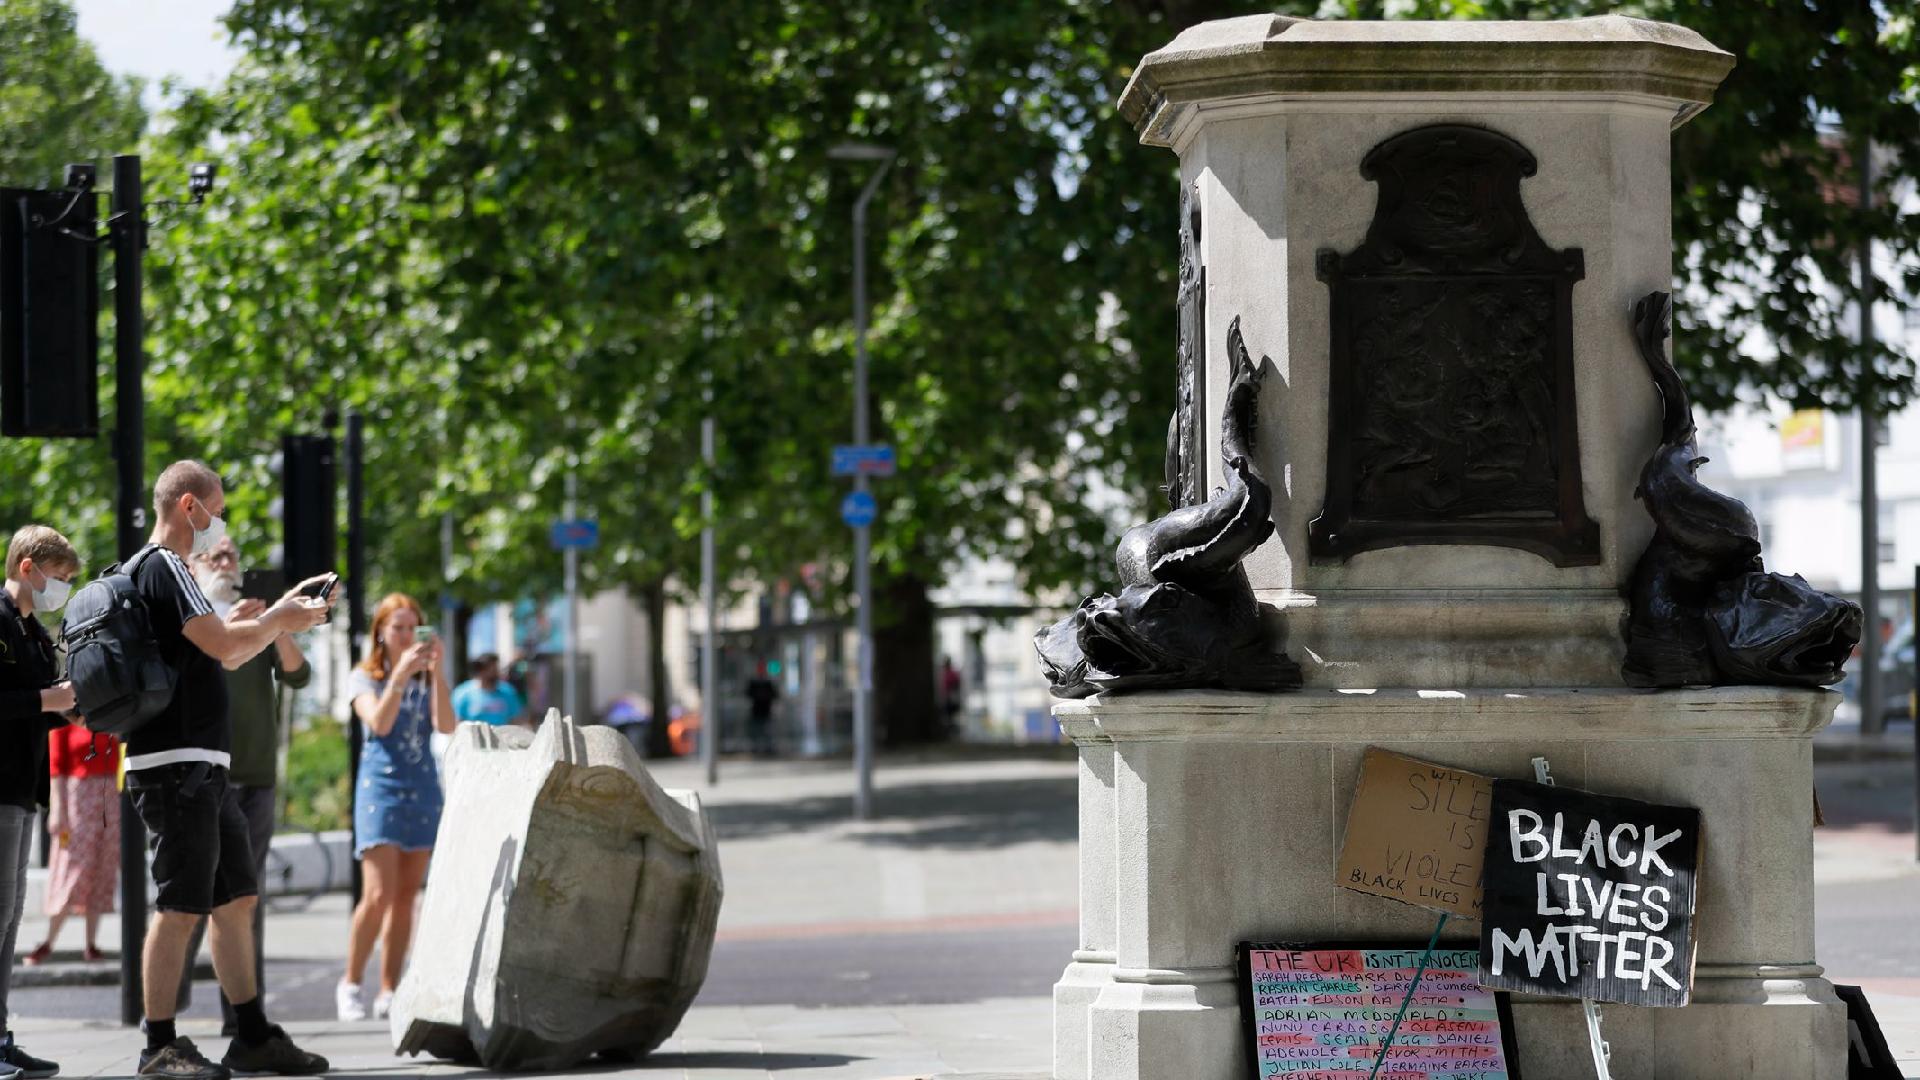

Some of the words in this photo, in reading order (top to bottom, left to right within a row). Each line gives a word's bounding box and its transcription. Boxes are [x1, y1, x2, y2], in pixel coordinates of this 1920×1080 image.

[1432, 769, 1492, 788] WHI
[1408, 773, 1490, 822] SILE
[1449, 822, 1475, 850] IS
[1508, 808, 1683, 877] BLACK
[1386, 843, 1482, 889] VIOLE
[1350, 867, 1407, 895] BLACK
[1419, 886, 1459, 904] LIVES
[1536, 872, 1671, 931] LIVES
[1255, 951, 1309, 971] THE
[1313, 953, 1358, 972] UK
[1404, 951, 1480, 969] INNOCEN
[1491, 922, 1682, 991] MATTER
[1255, 973, 1289, 982] SARAH
[1295, 973, 1324, 983] REED
[1340, 972, 1386, 982] MARK
[1394, 971, 1455, 981] DUGAN
[1258, 983, 1308, 995] RASHAN
[1313, 983, 1362, 993] CHARLES
[1373, 983, 1430, 992] DARRN
[1259, 995, 1298, 1006] BATCH
[1312, 993, 1364, 1005] EDSON
[1371, 996, 1392, 1005] DA
[1264, 1009, 1332, 1022] ADRIAN
[1311, 1022, 1389, 1035] CARDOSO
[1410, 1021, 1484, 1032] OLASENI
[1260, 1033, 1303, 1046] LEWIS
[1322, 1033, 1369, 1046] SEAN
[1437, 1033, 1495, 1044] DANIEL
[1265, 1047, 1338, 1059] ADEWOLE
[1360, 1048, 1420, 1059] TREVOR
[1426, 1047, 1478, 1057] SMITH
[1266, 1060, 1321, 1073] JULIAN
[1454, 1059, 1500, 1069] BAKER
